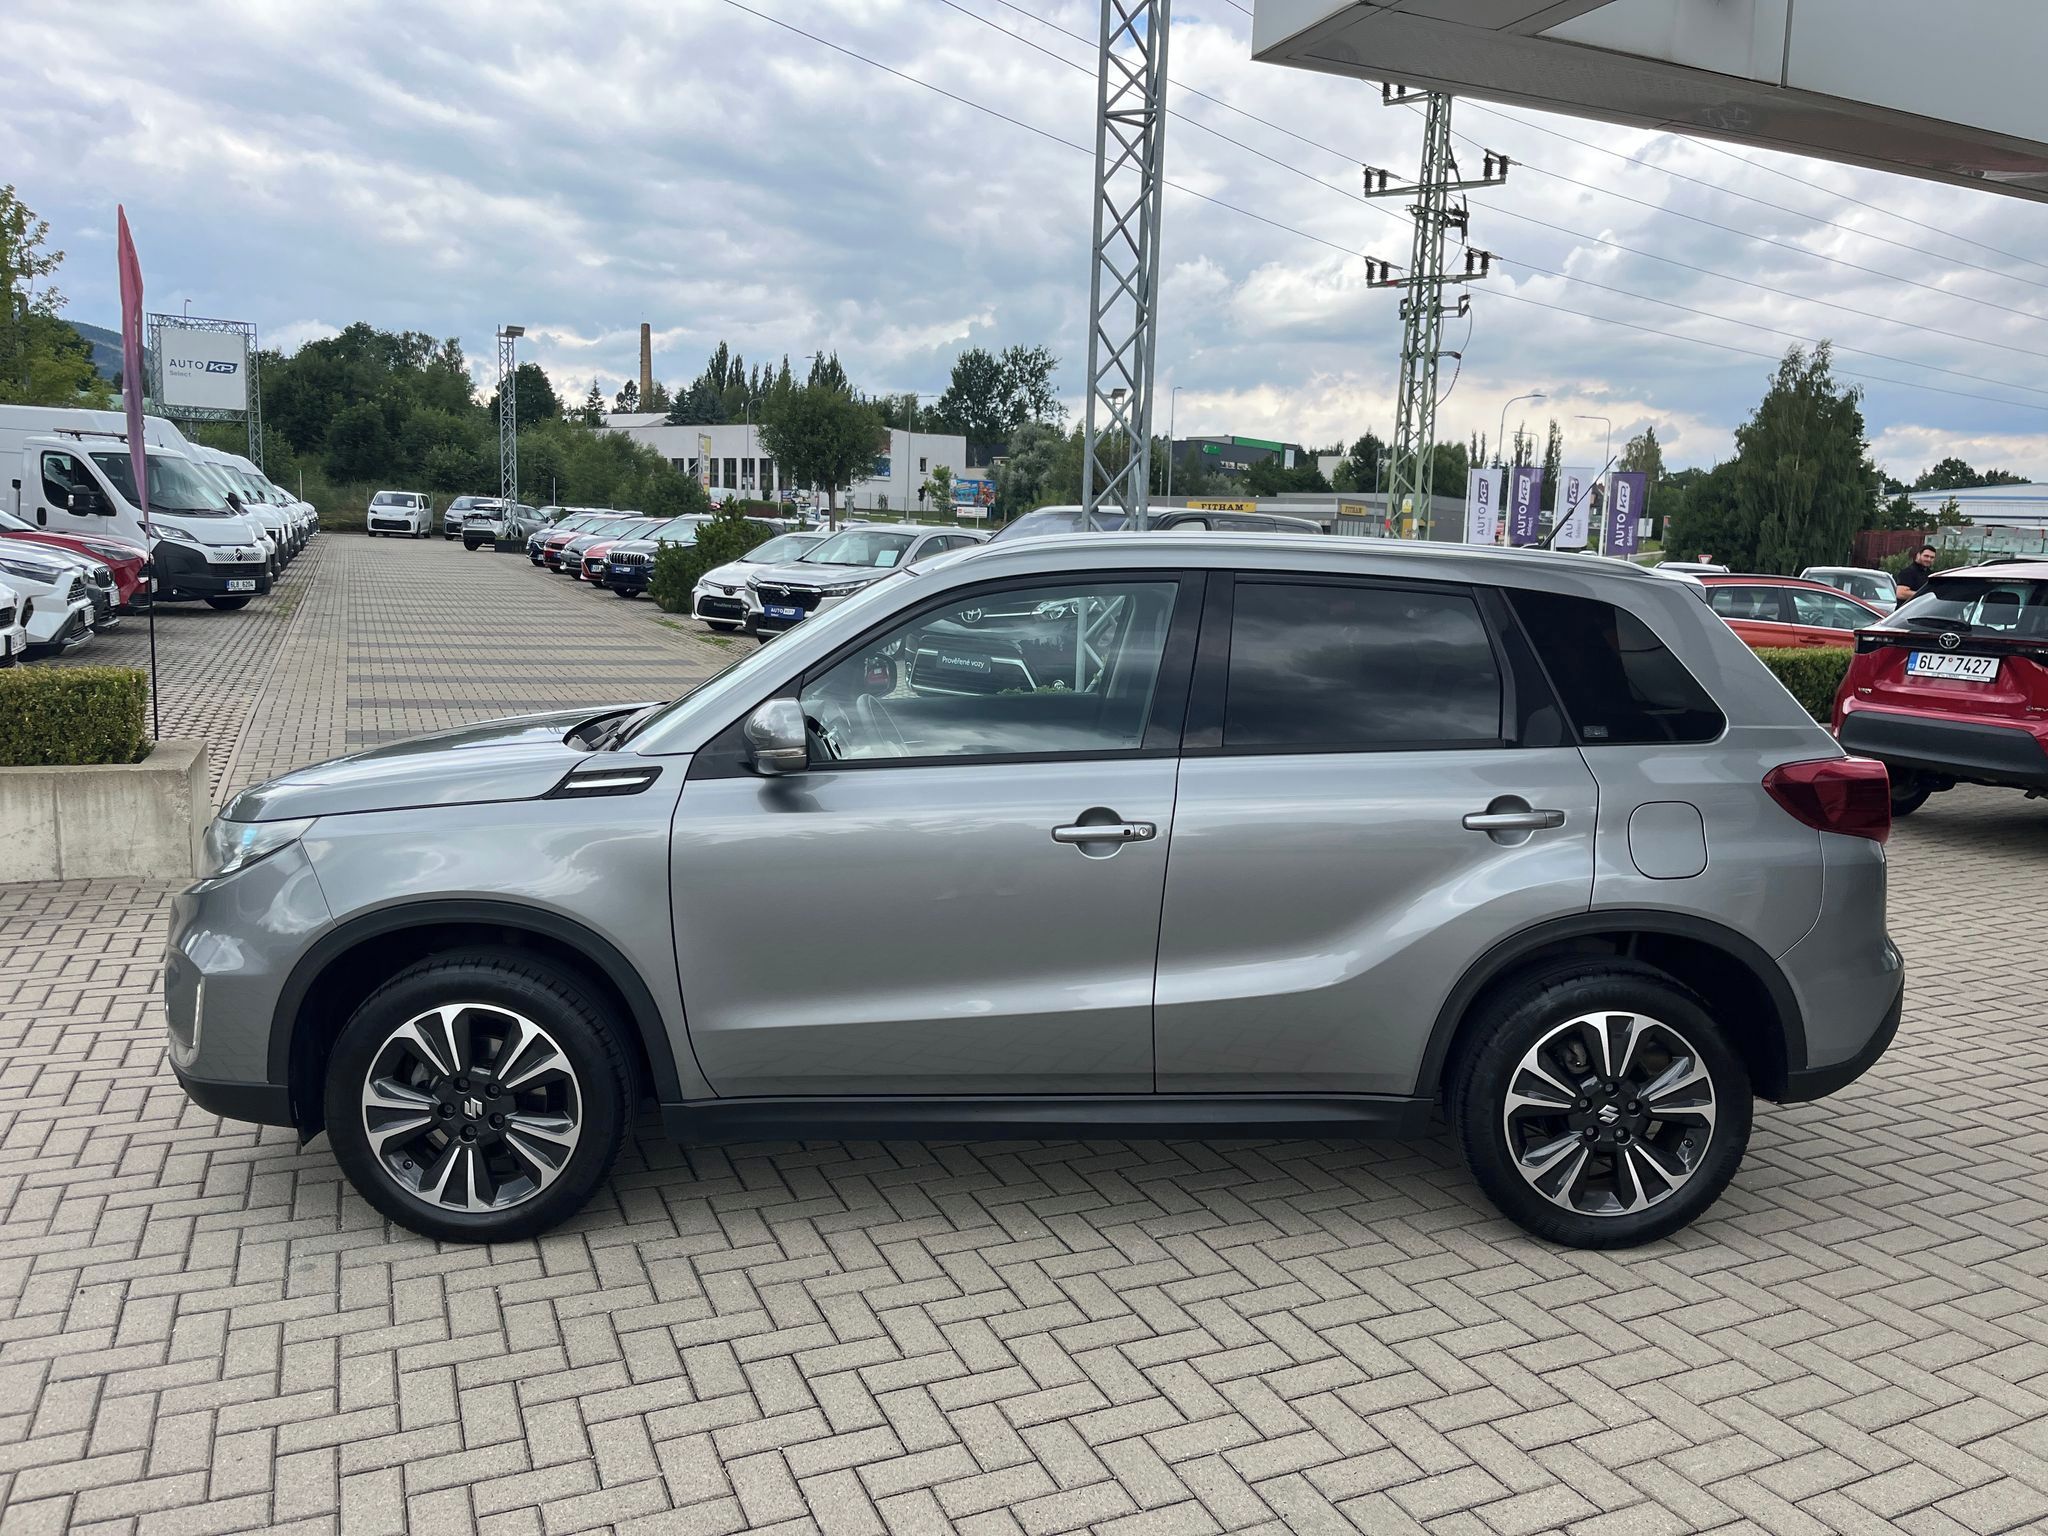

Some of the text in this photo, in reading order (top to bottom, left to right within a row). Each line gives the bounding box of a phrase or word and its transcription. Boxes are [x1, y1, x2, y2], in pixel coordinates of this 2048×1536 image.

[169, 359, 204, 369] AUTO
[1201, 503, 1243, 511] FITHAM
[1477, 507, 1486, 536] AUTO
[1517, 505, 1527, 536] AUTO
[1615, 513, 1626, 546] AUTO
[942, 655, 985, 669] Prověřené vozy
[1919, 655, 1992, 675] 6L7 7427
